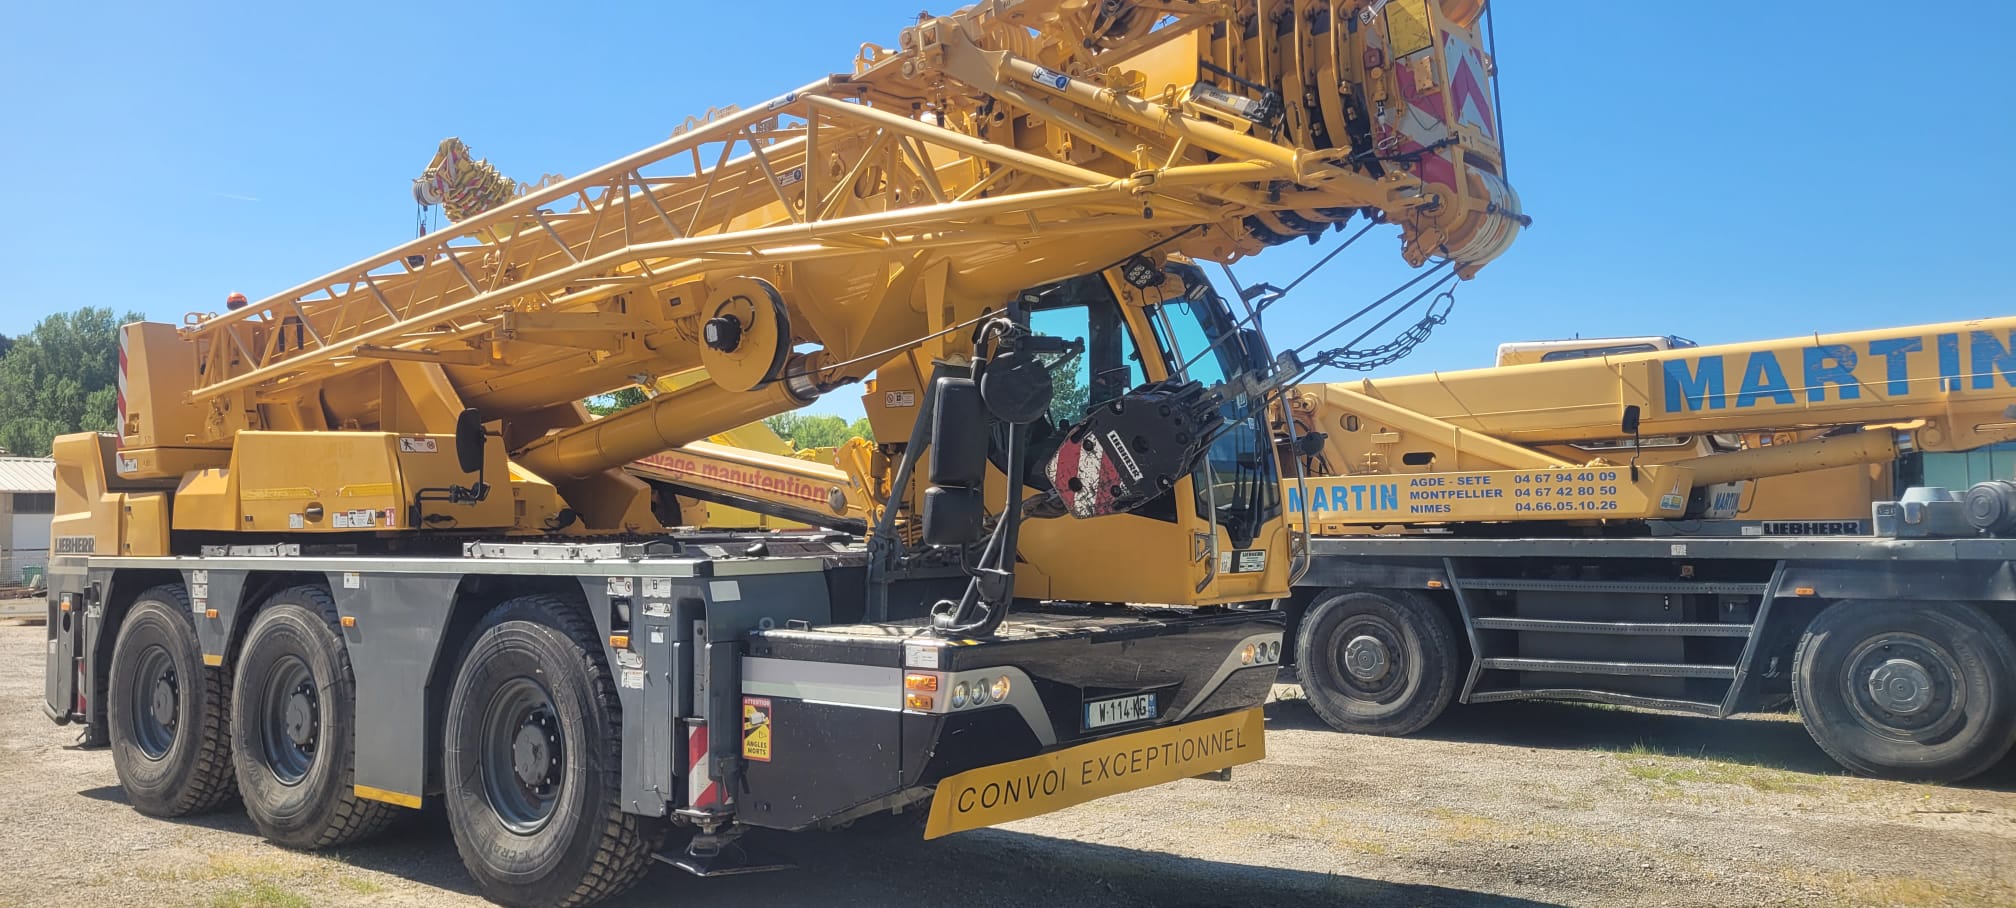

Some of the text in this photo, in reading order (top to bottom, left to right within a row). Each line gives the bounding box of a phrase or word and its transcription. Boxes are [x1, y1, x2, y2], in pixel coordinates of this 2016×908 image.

[1663, 327, 2016, 413] MARTIN
[1109, 433, 1140, 478] LIEBHERR
[702, 461, 827, 504] manutention
[1410, 477, 1445, 487] AGDE
[1457, 475, 1491, 485] SETE
[1514, 475, 1530, 484] 04
[1535, 474, 1551, 483] 67
[1556, 473, 1572, 482] 94
[1577, 472, 1594, 482] 40
[1599, 472, 1616, 481] 09
[1288, 484, 1399, 513] MARTIN
[1410, 486, 1616, 500] MONTPELLIER 04 67 42 80 50
[1713, 492, 1740, 510] MARTIN
[1410, 500, 1617, 513] NIMES 04.66.05.10.26
[1763, 522, 1859, 535] LIEBHERR
[55, 537, 95, 553] LIEBHERR
[746, 740, 767, 749] ANGLES
[747, 747, 767, 755] MORTS
[957, 726, 1247, 813] CONVOI EXCEPTIONNEL
